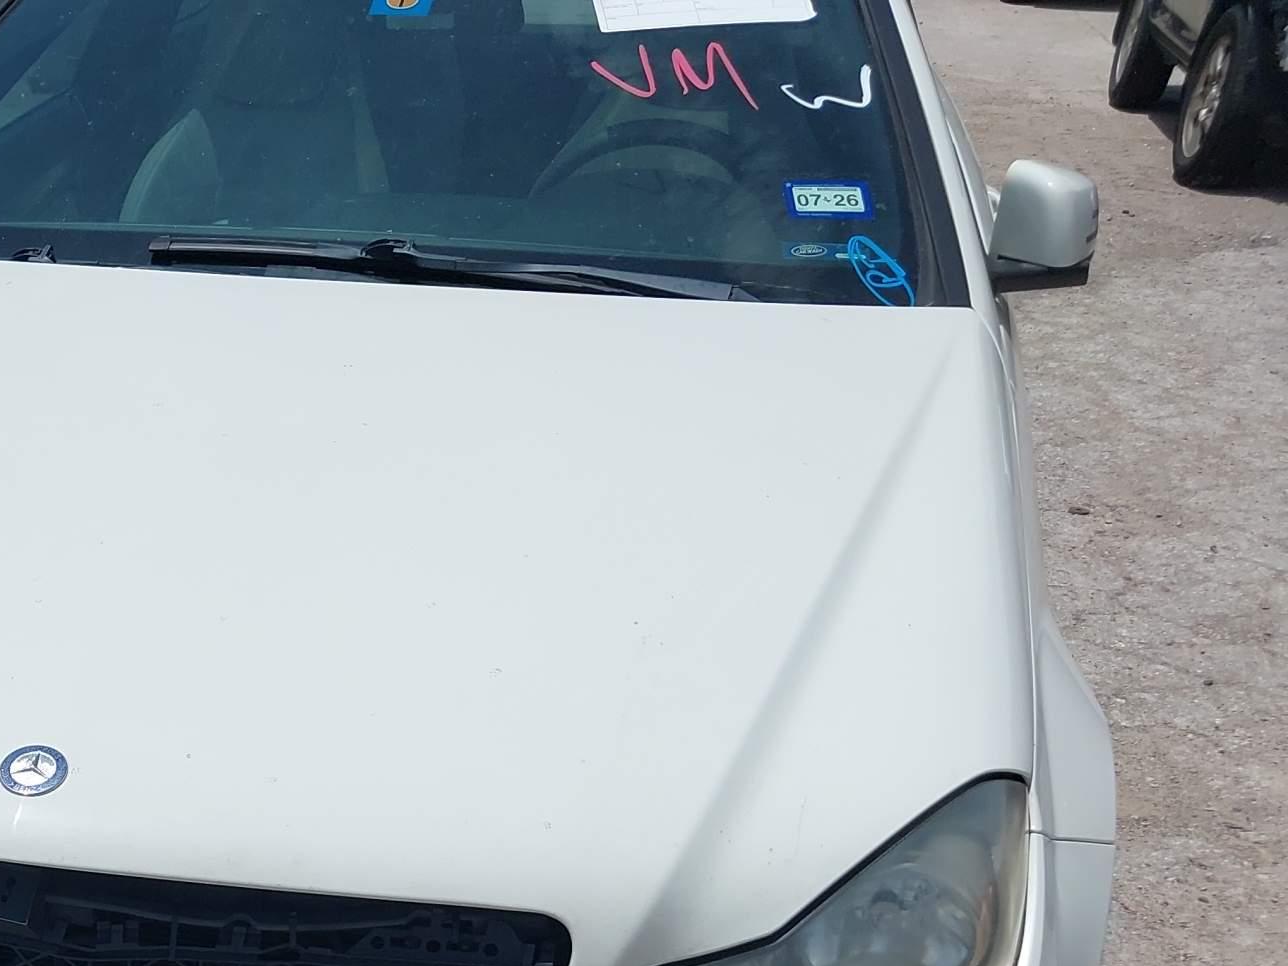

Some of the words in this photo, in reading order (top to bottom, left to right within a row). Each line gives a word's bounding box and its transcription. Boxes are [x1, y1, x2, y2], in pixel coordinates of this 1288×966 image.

[590, 42, 759, 110] VM
[797, 194, 821, 206] 07
[833, 194, 859, 206] 26
